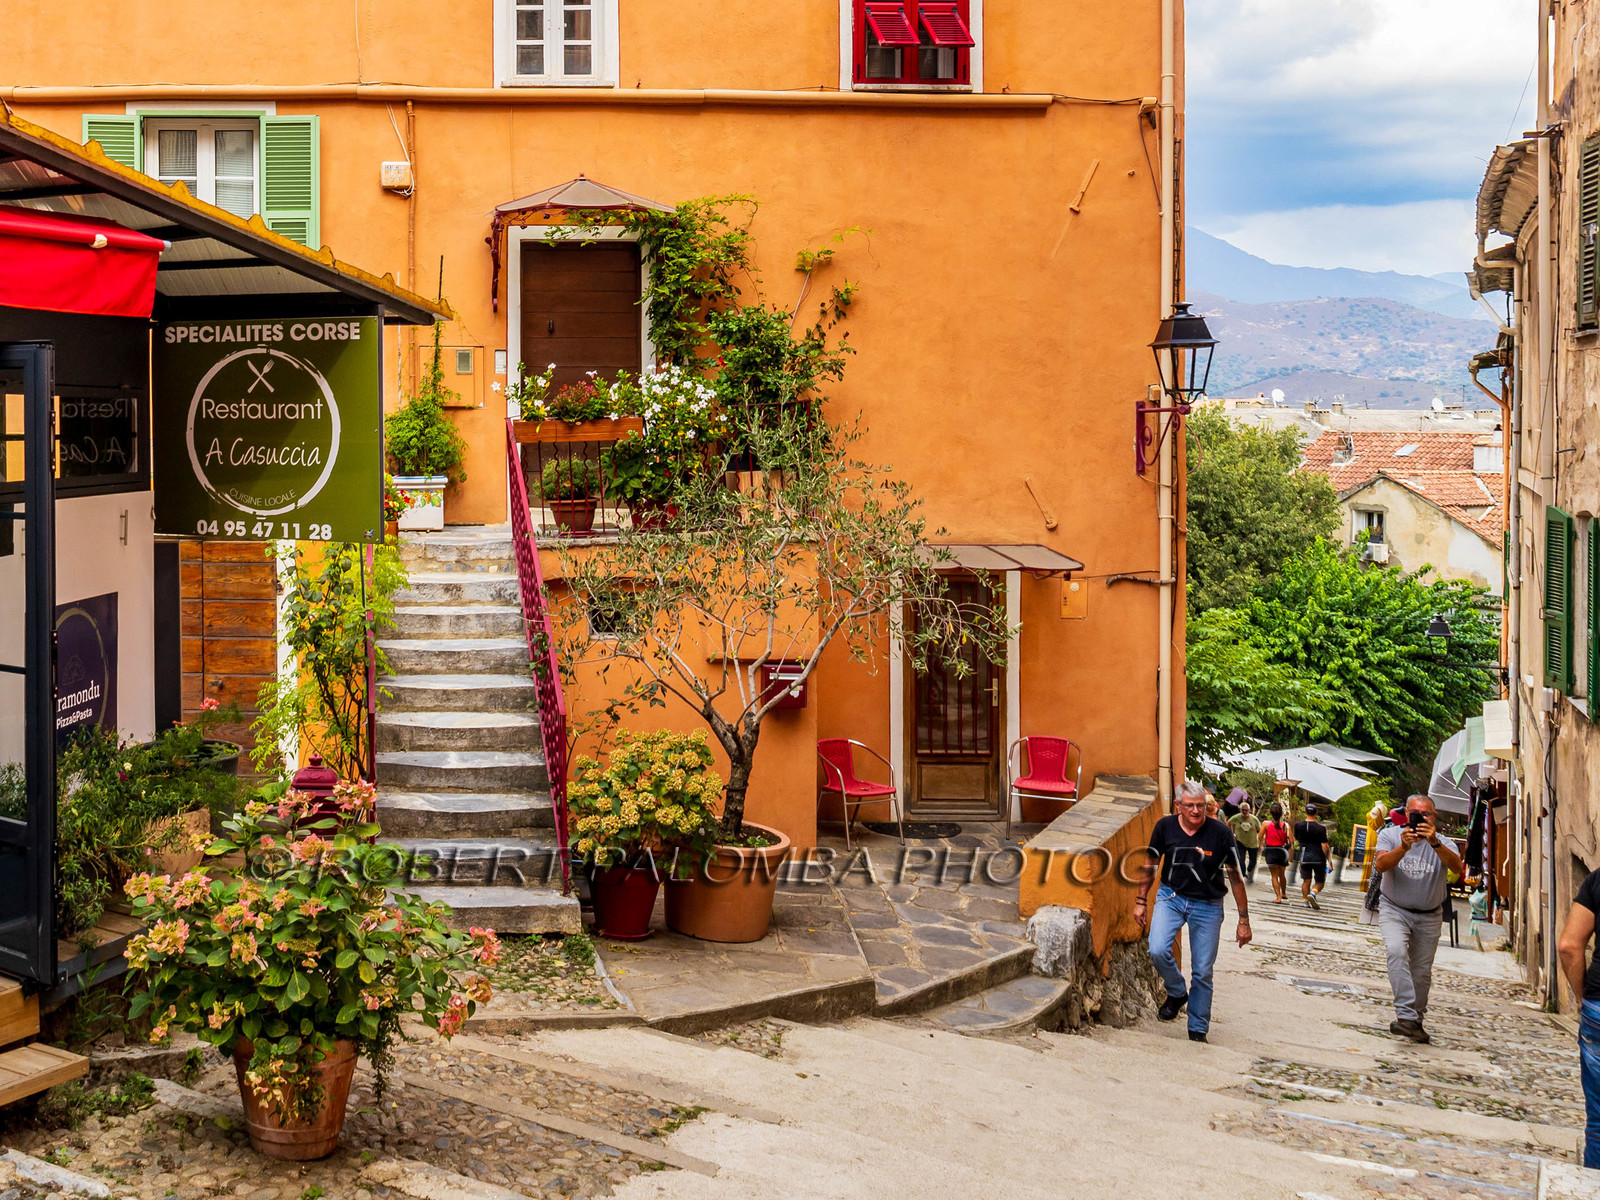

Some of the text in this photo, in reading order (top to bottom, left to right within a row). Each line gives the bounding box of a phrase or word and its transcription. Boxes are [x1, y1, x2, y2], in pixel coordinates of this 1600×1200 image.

[165, 322, 361, 344] SPECIALITES CORSE
[202, 398, 323, 420] Restaurant
[205, 437, 321, 467] A Casuccia
[229, 487, 297, 507] CUISINE LOCALE
[196, 519, 333, 541] 04 95 47 11 28
[57, 680, 101, 712] ramondu
